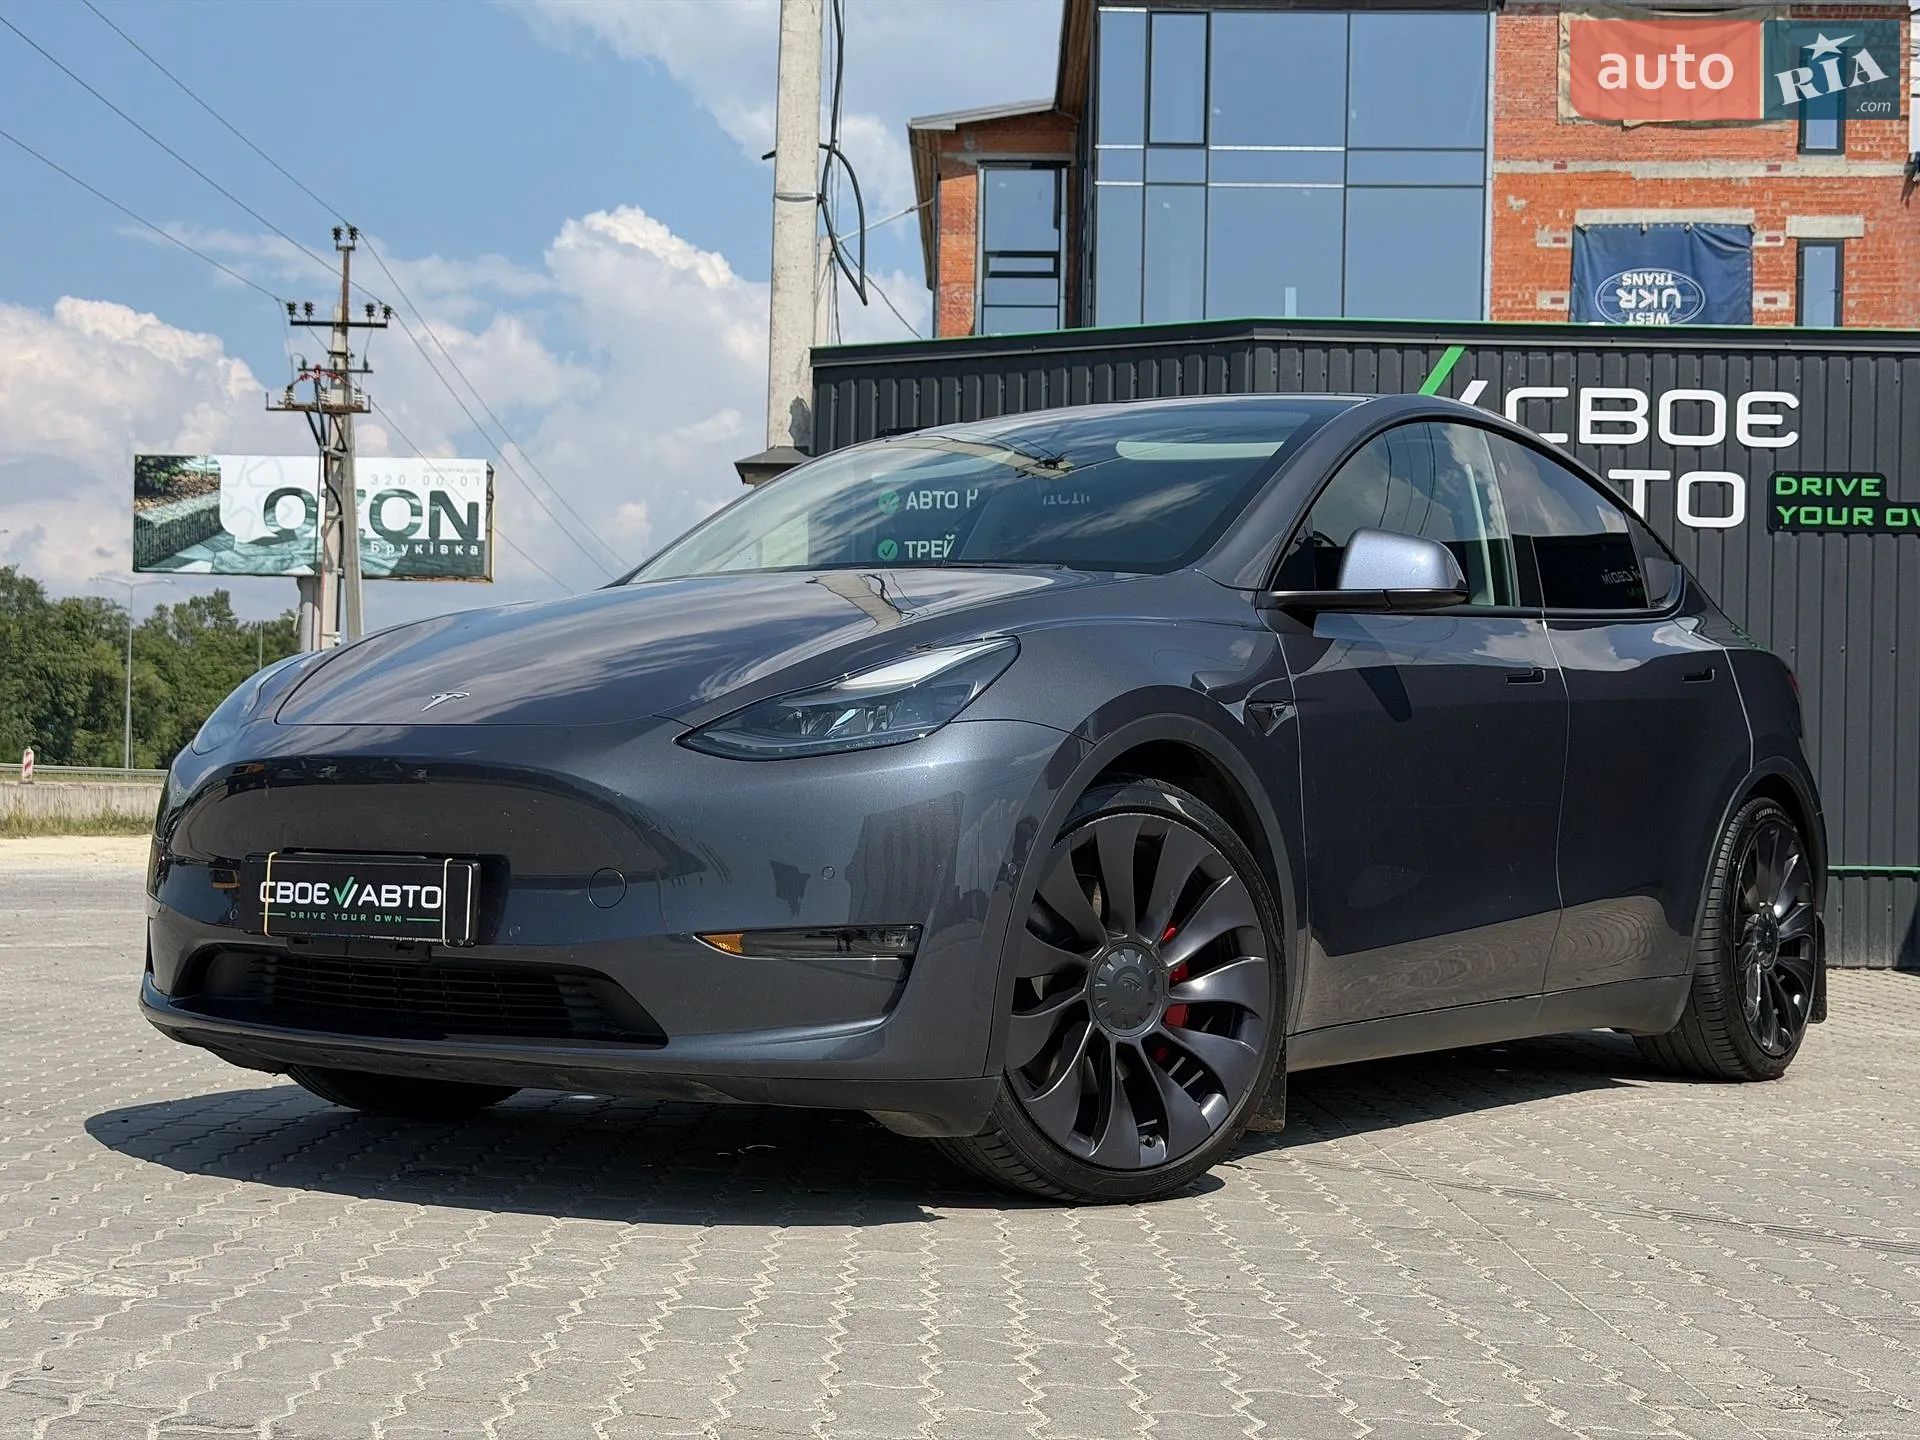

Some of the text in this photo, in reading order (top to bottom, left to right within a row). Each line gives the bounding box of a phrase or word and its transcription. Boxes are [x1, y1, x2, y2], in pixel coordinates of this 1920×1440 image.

[1622, 273, 1674, 286] TRANS
[1616, 288, 1681, 309] UKR
[1625, 312, 1670, 325] WEST
[1775, 477, 1881, 497] DRIVE
[906, 490, 958, 510] АВТО
[264, 487, 479, 540] OON
[1776, 506, 1920, 527] YOUR O
[357, 884, 443, 909] АВТО
[290, 911, 403, 923] DRIVE YOUR OWN
